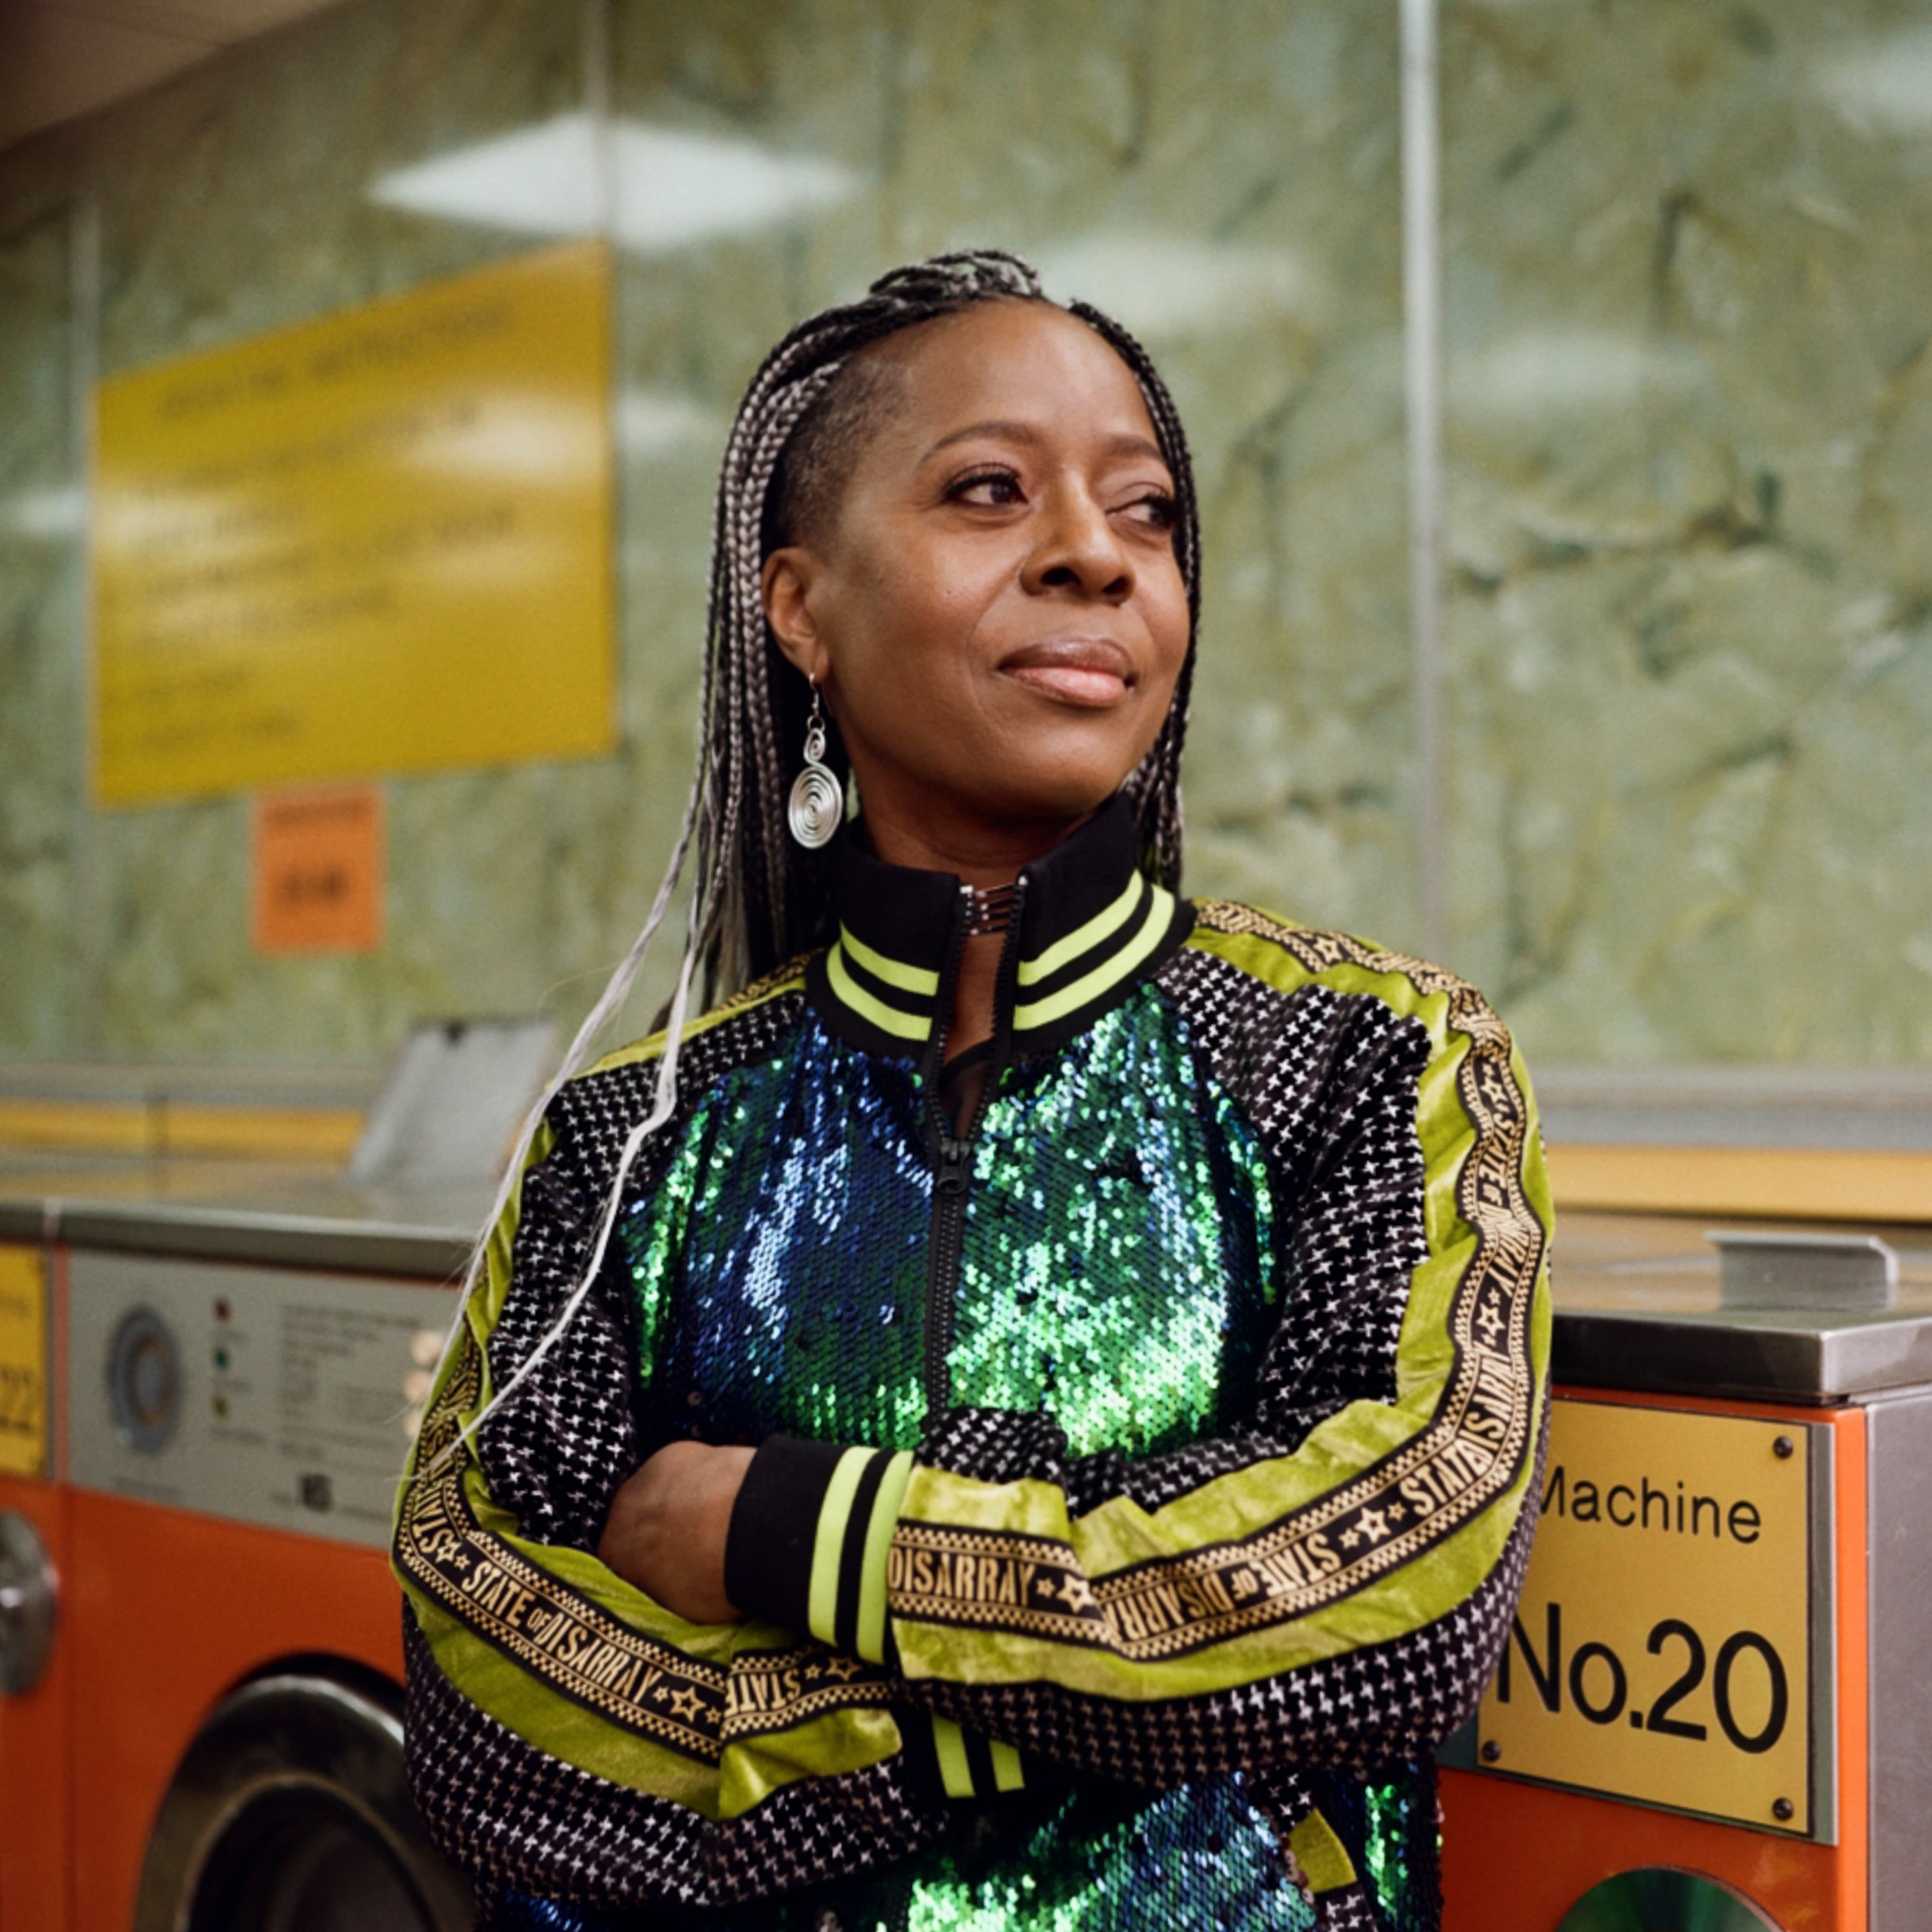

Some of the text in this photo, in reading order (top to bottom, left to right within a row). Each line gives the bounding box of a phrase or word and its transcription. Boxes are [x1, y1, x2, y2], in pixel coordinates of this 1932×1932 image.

[1478, 1113, 1516, 1189] STATE
[1478, 1201, 1530, 1298] DRRAY
[1540, 1465, 1761, 1543] Machine
[887, 1547, 1036, 1608] DISARRAY
[1103, 1533, 1341, 1643] STATE OF DISARRA
[462, 1560, 664, 1704] STATE OF DISARRAY
[1497, 1602, 1788, 1754] No.20
